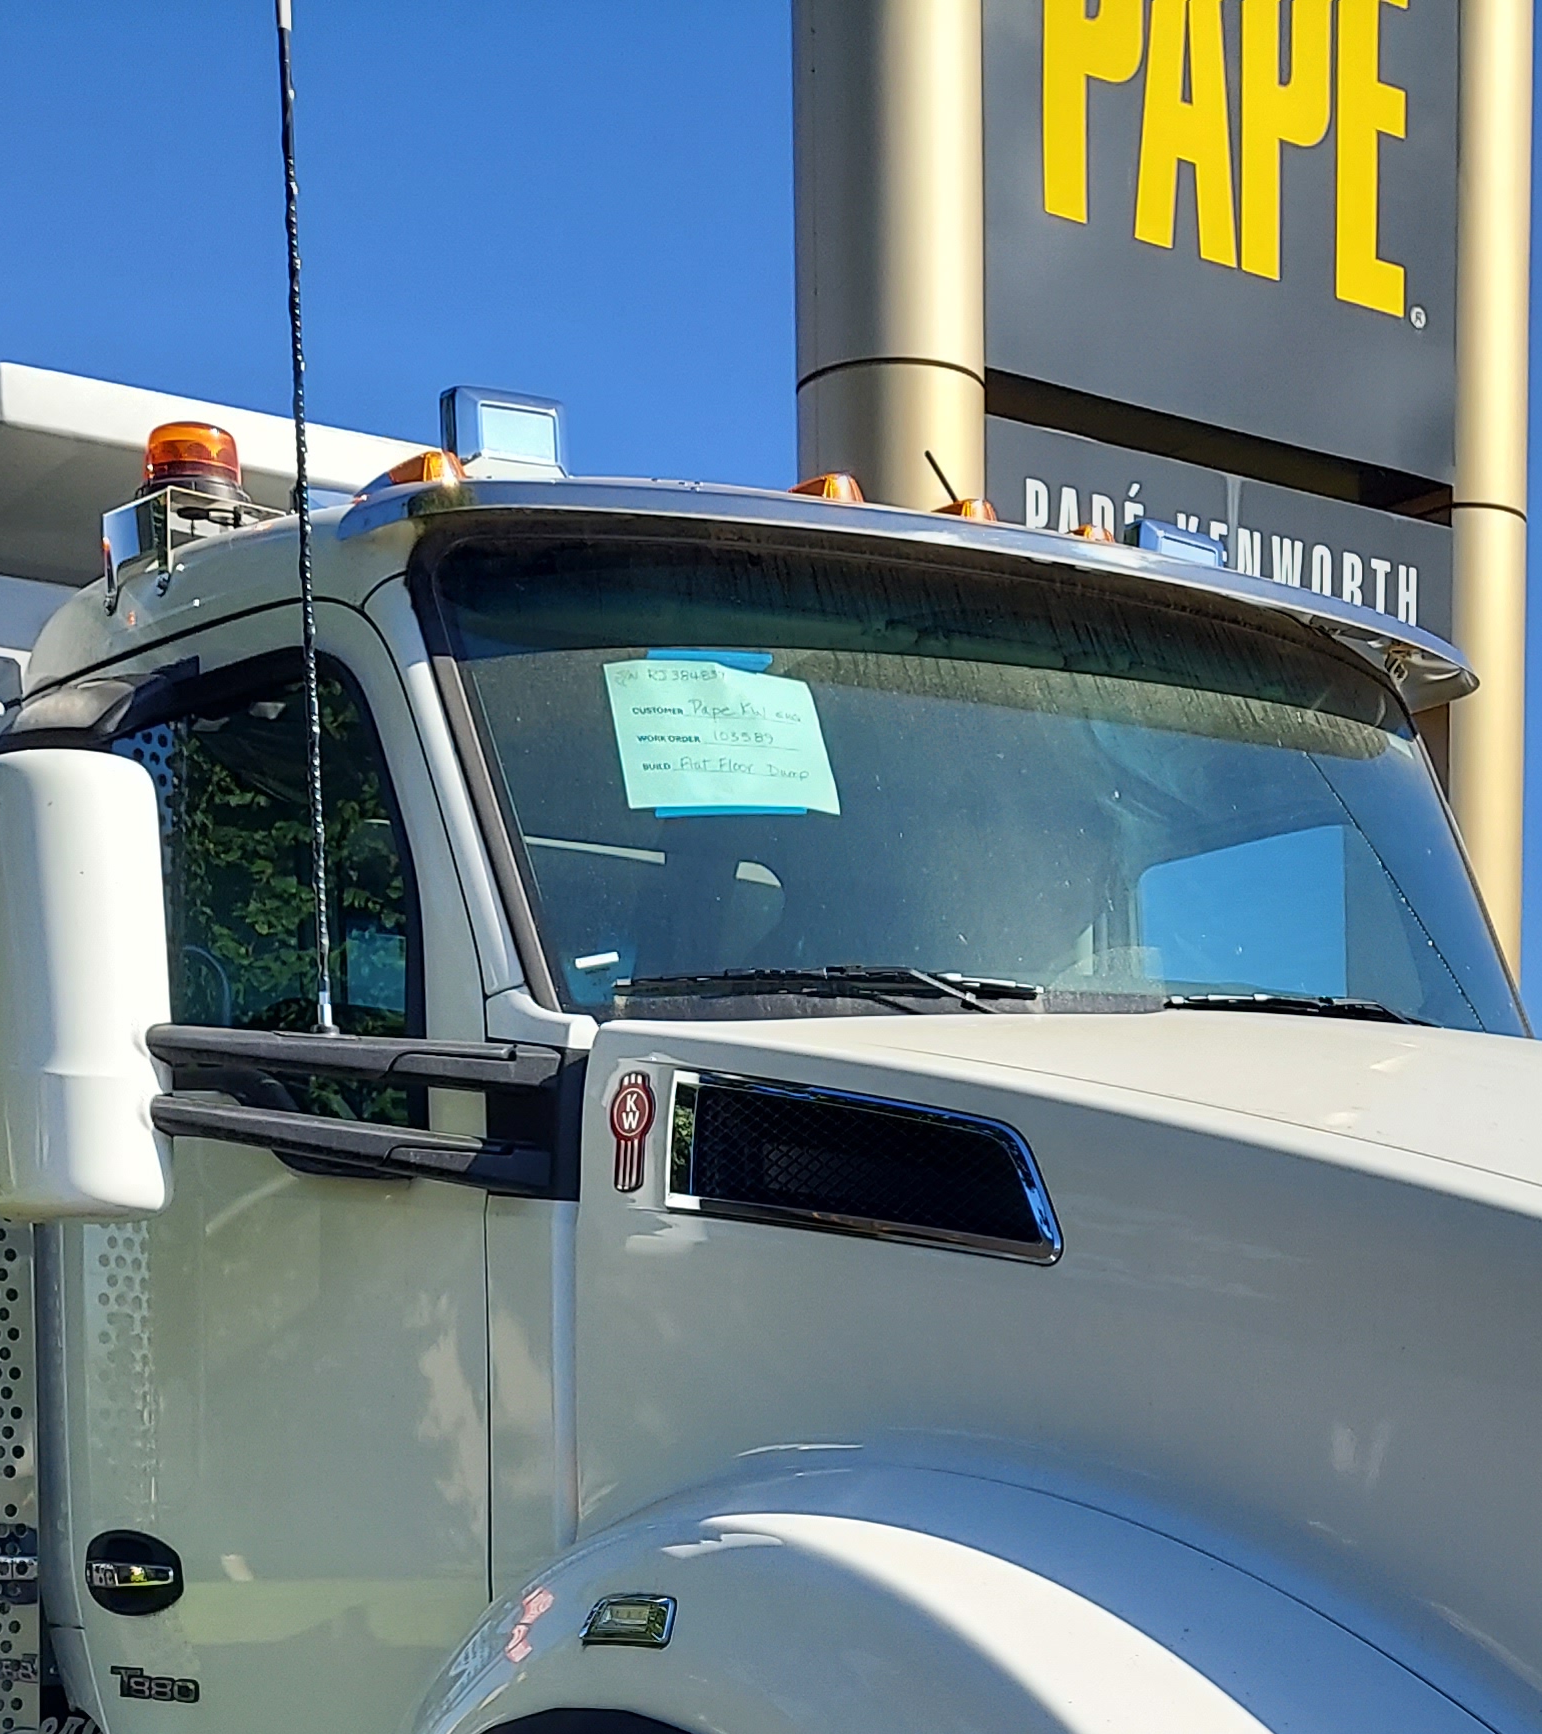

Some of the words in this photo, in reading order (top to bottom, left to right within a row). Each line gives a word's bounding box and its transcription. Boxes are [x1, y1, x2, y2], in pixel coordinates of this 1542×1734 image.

[632, 706, 684, 716] CUSTOMER
[637, 734, 667, 743] WORK
[668, 734, 701, 743] ORDER
[642, 762, 671, 771] BUILD
[766, 763, 810, 781] Dump
[110, 1665, 200, 1703] T880
